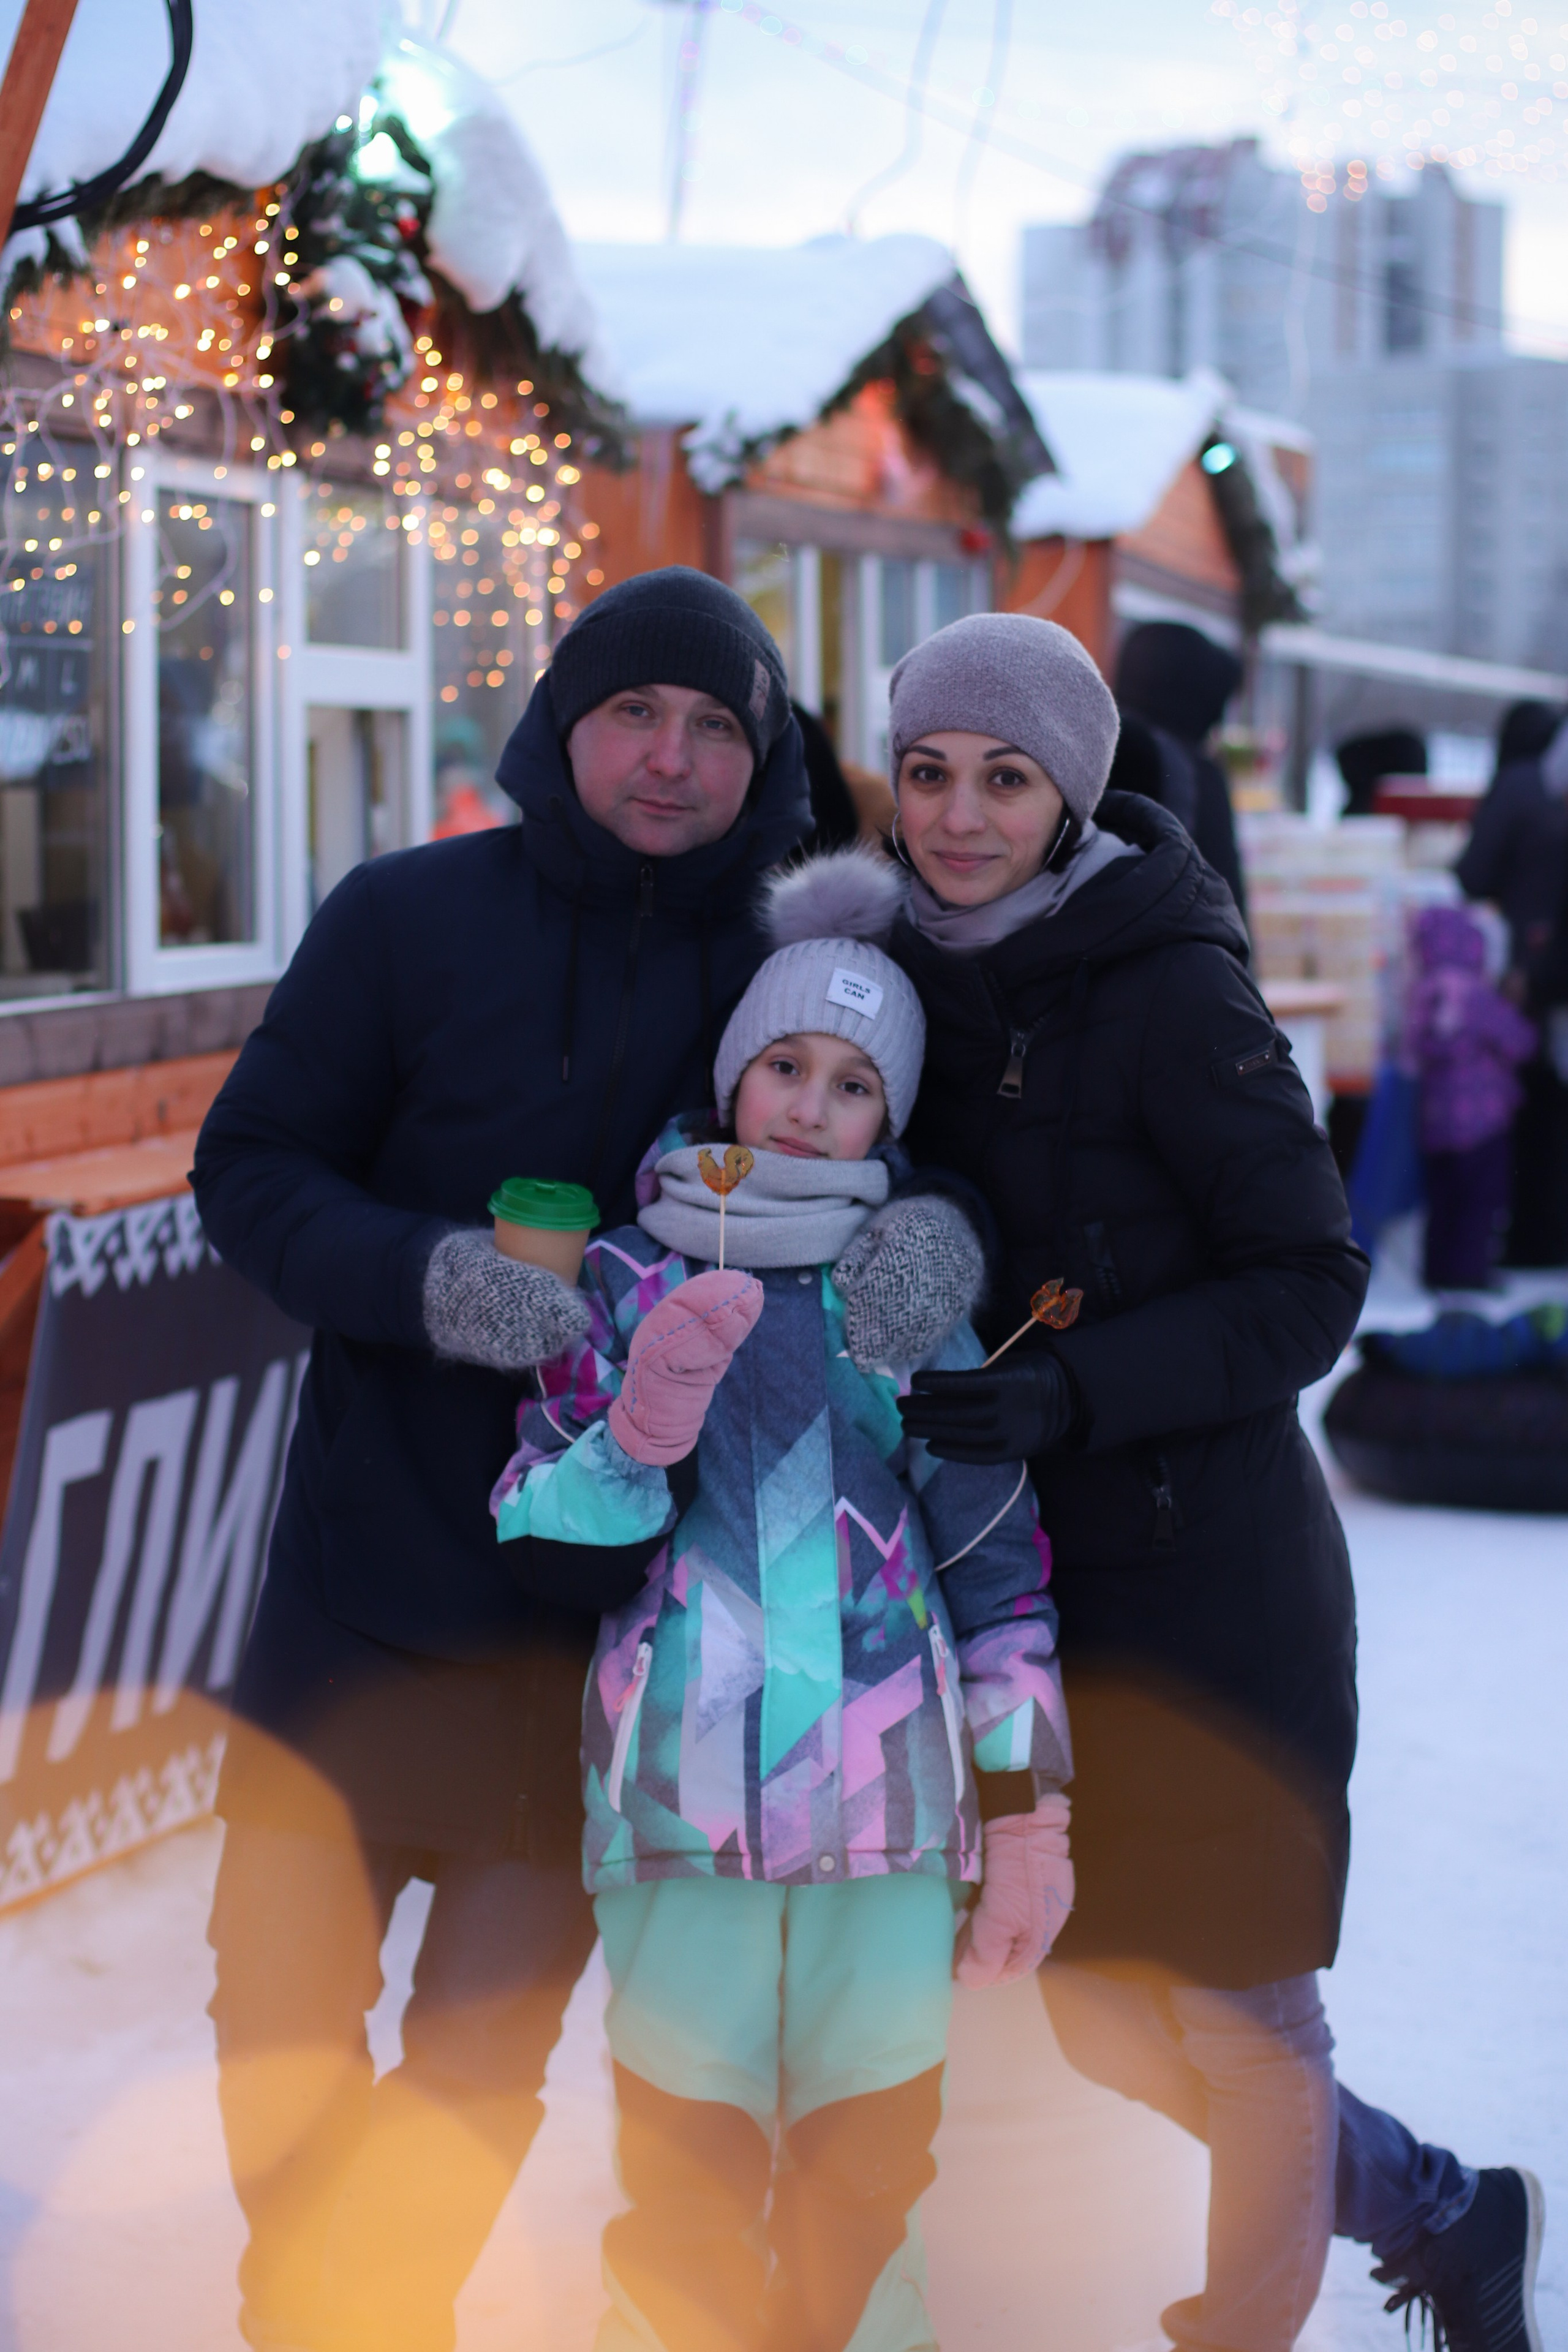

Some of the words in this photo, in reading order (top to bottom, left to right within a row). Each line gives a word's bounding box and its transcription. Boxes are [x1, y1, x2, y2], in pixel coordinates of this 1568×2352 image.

[842, 979, 870, 993] GIRLS
[844, 987, 865, 1000] CAN
[0, 1350, 310, 1784] ГЛИ
